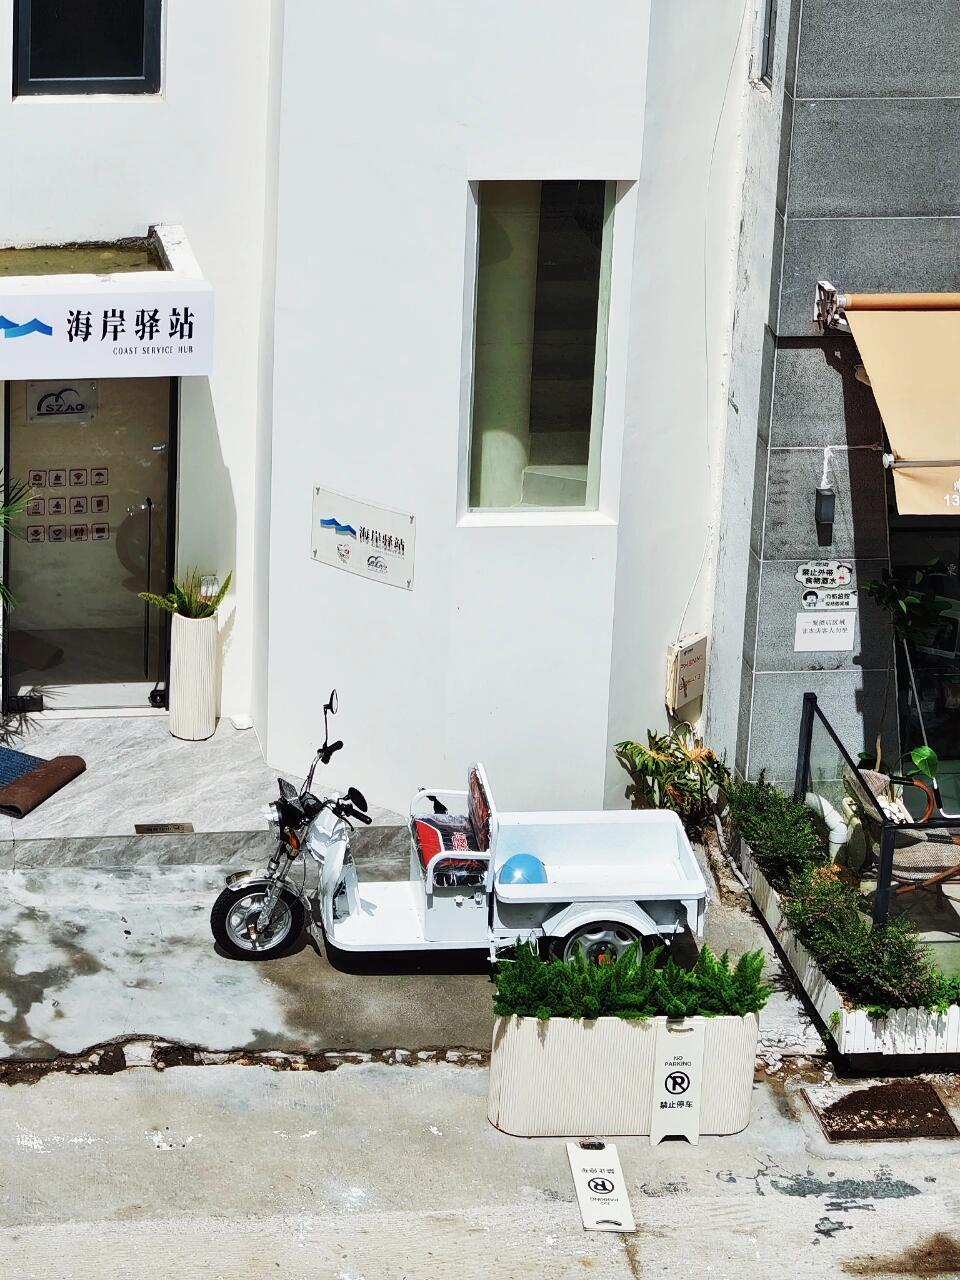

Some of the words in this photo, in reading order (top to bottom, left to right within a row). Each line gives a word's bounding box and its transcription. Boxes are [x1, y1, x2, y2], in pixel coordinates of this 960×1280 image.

[66, 306, 195, 342] 海岸驿站
[112, 346, 138, 355] COAST
[142, 345, 173, 354] SERVICE
[178, 345, 193, 354] HUB
[359, 525, 405, 556] 海岸驿站
[805, 577, 837, 585] 食物酒水
[660, 1100, 693, 1109] 禁止停车
